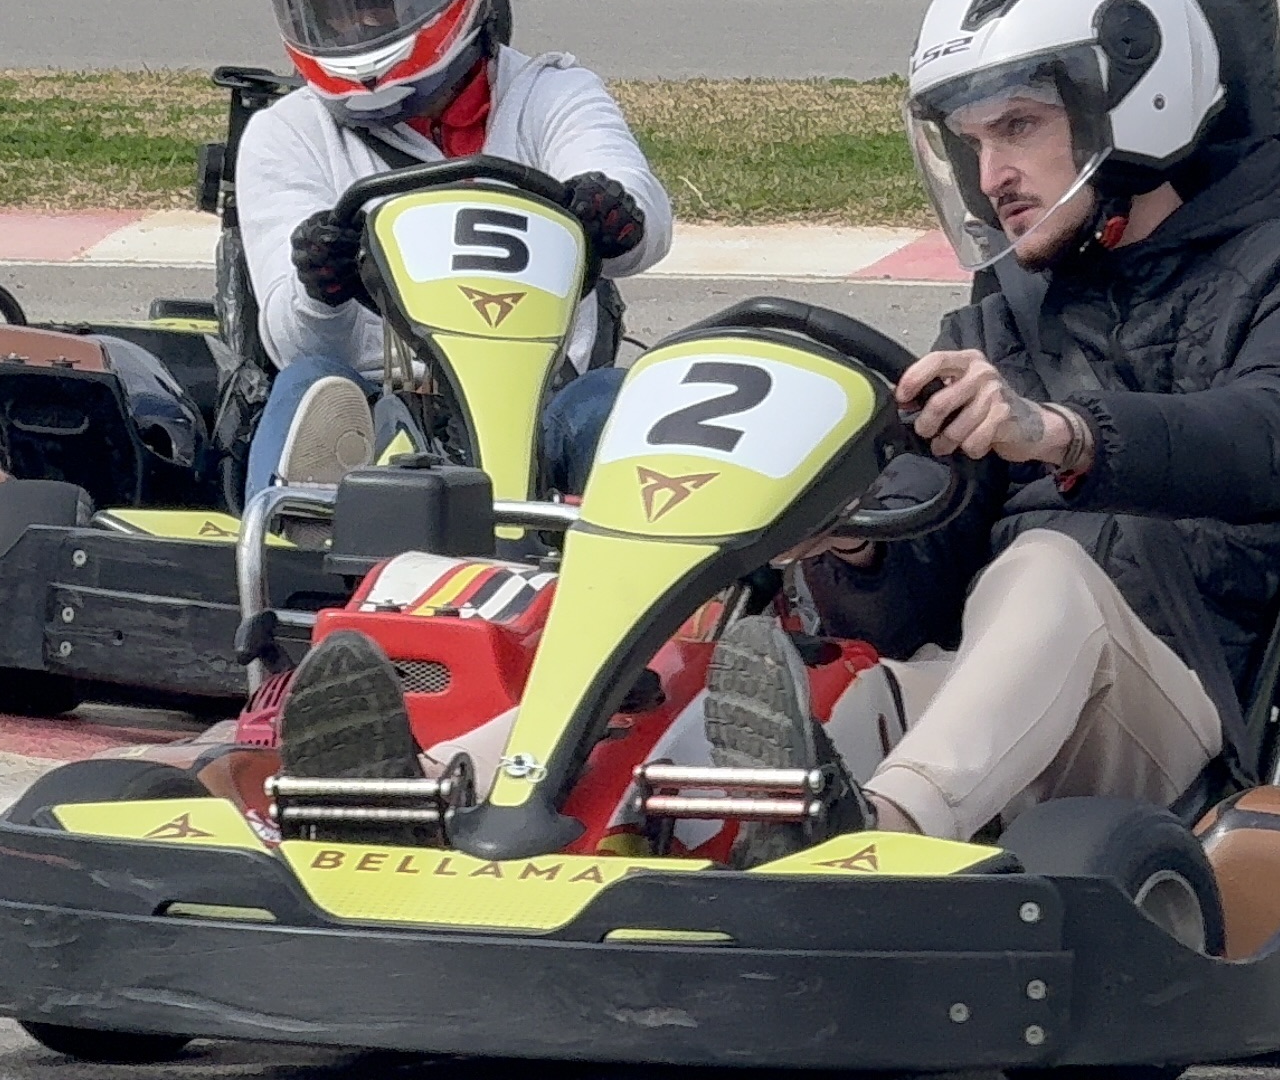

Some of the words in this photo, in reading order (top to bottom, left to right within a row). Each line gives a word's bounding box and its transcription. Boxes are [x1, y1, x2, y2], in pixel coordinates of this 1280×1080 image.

[911, 35, 975, 76] LS2
[451, 208, 530, 274] 5
[646, 361, 773, 453] 2
